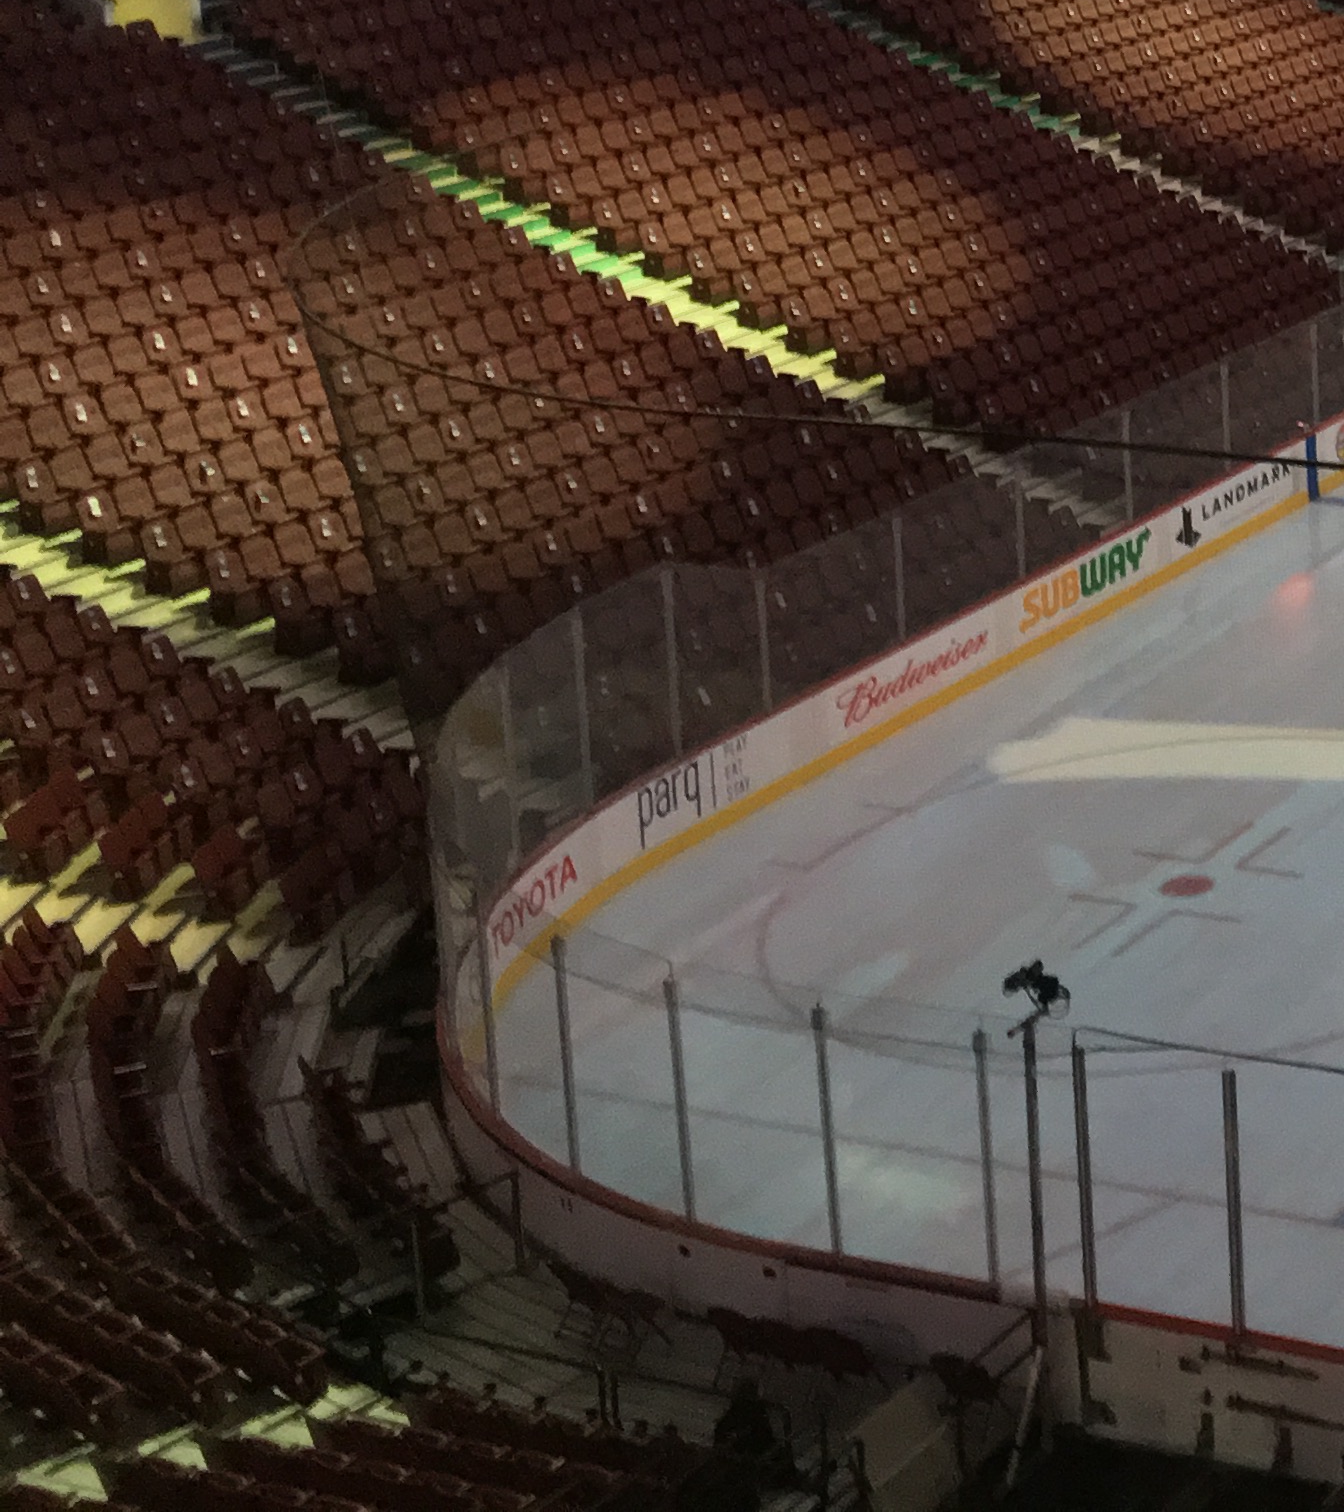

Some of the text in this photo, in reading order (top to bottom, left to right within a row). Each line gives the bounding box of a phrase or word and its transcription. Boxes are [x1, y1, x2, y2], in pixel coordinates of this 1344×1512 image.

[1019, 526, 1151, 634] SUBWAY
[836, 629, 989, 728] Budweiser
[637, 760, 702, 850] parq
[492, 854, 579, 961] TOYOTA
